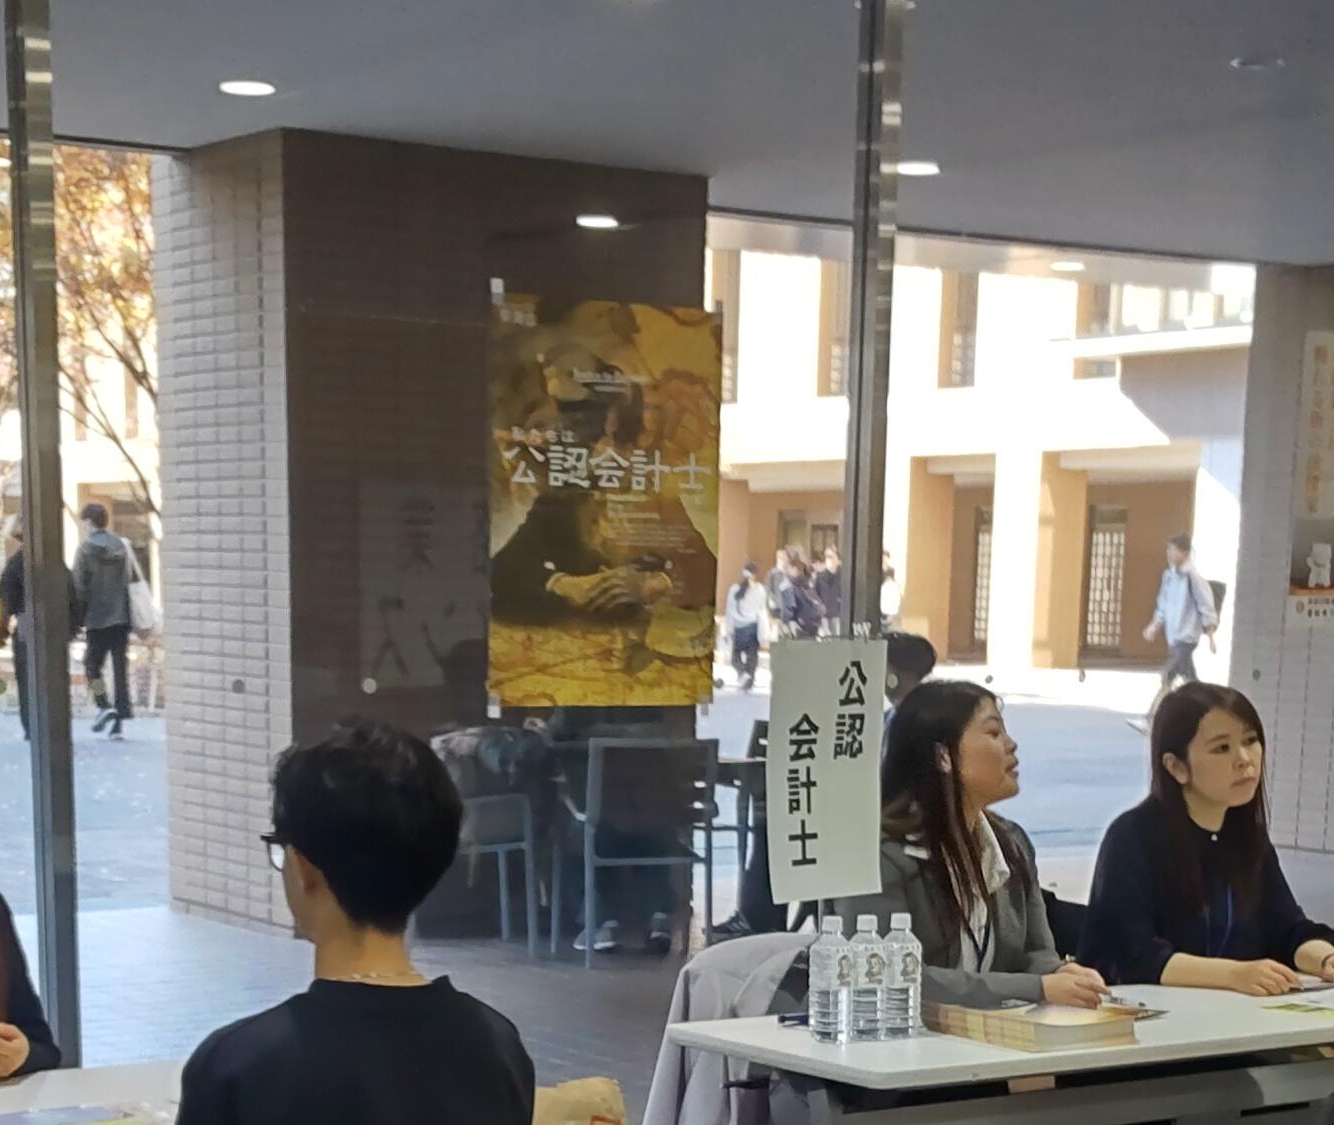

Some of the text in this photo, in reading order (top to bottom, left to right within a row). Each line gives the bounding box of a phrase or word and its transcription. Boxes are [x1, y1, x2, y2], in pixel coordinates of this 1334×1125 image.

[502, 446, 712, 494] 公認会計士
[833, 660, 868, 760] 公認
[786, 713, 820, 867] 会計士
